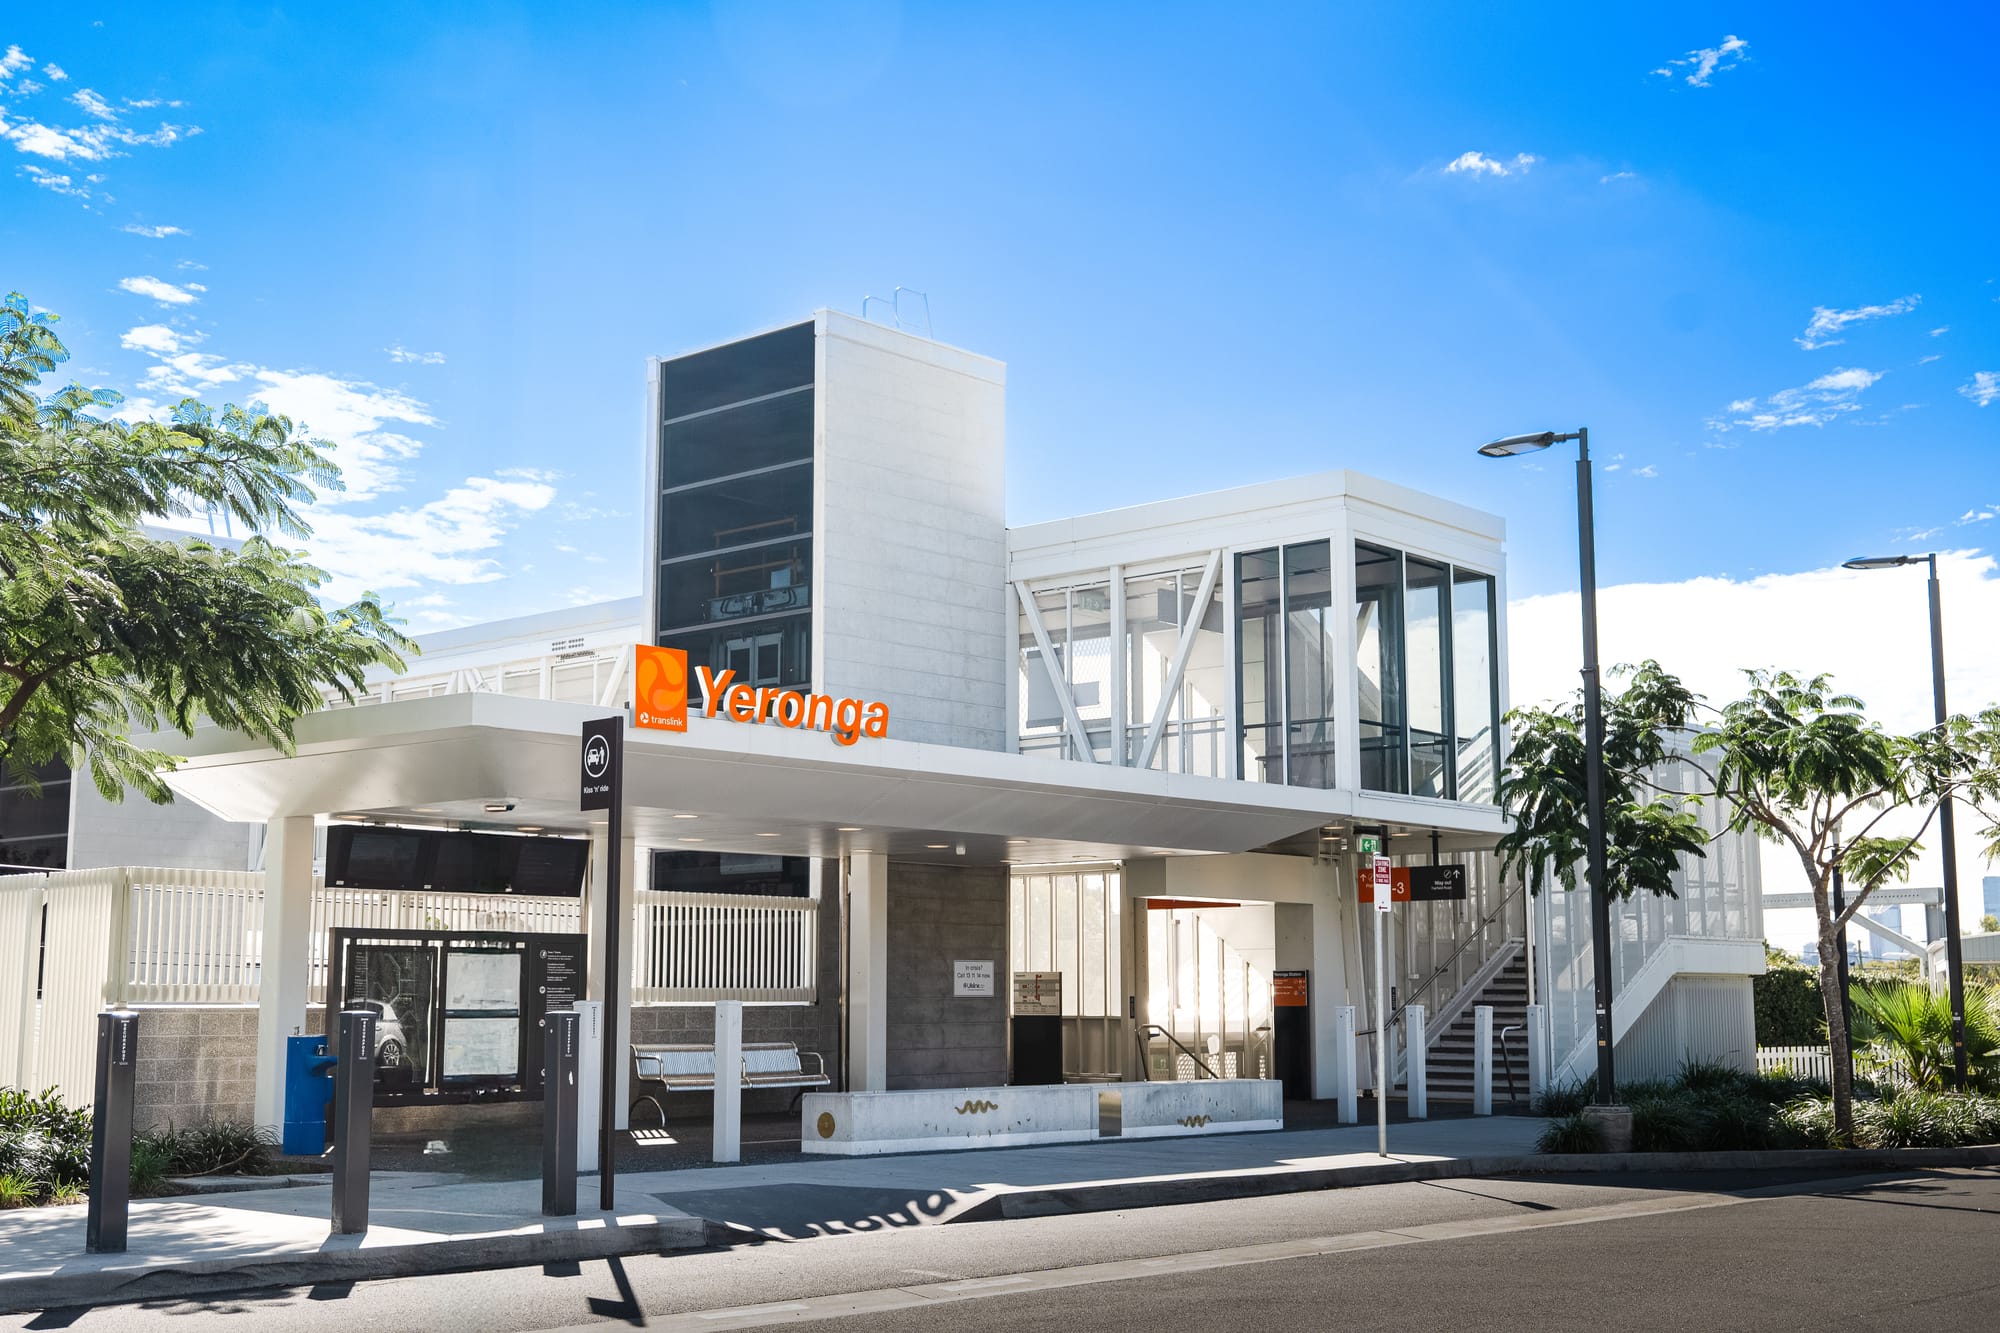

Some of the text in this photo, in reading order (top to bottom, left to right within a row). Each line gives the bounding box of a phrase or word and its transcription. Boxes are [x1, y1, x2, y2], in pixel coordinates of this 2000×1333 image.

[695, 665, 889, 746] Yeronga
[651, 715, 683, 727] translink
[583, 786, 594, 794] Kiss
[600, 784, 609, 792] ride
